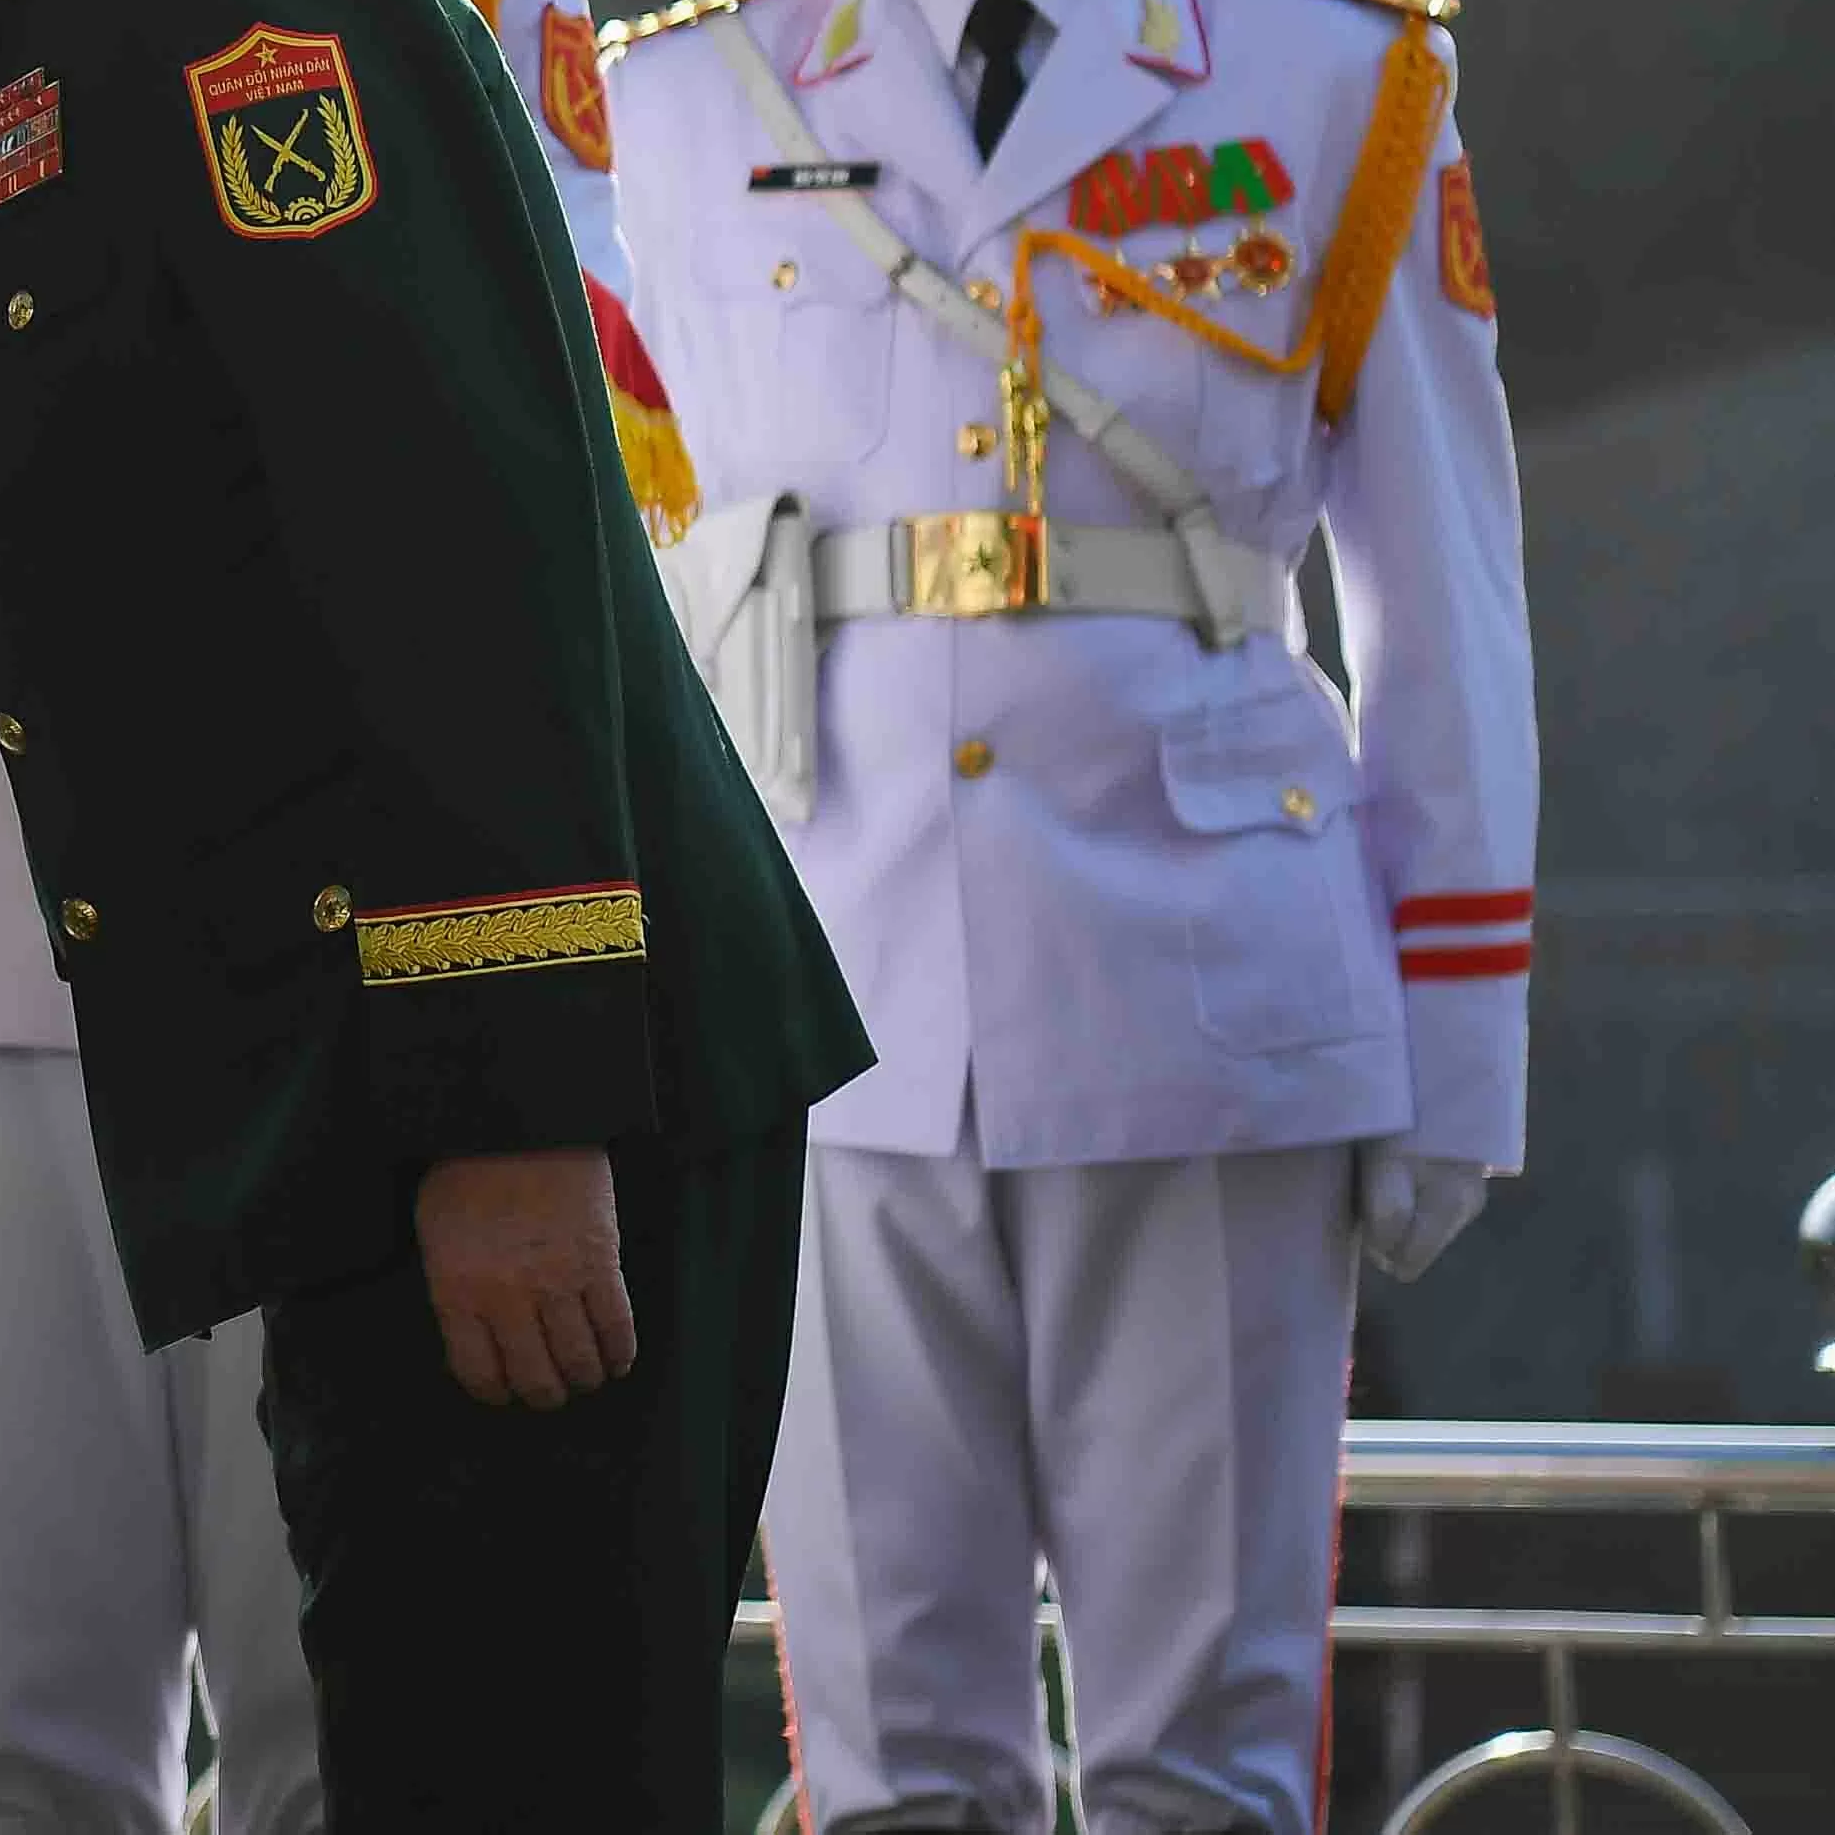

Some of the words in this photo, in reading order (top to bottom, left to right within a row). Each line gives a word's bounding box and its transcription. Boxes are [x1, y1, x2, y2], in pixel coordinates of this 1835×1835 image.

[209, 76, 244, 97] QUÂN
[270, 61, 304, 81] NHÂN
[306, 57, 331, 74] DÂN
[245, 83, 272, 102] VIỆT
[276, 79, 305, 95] NAM
